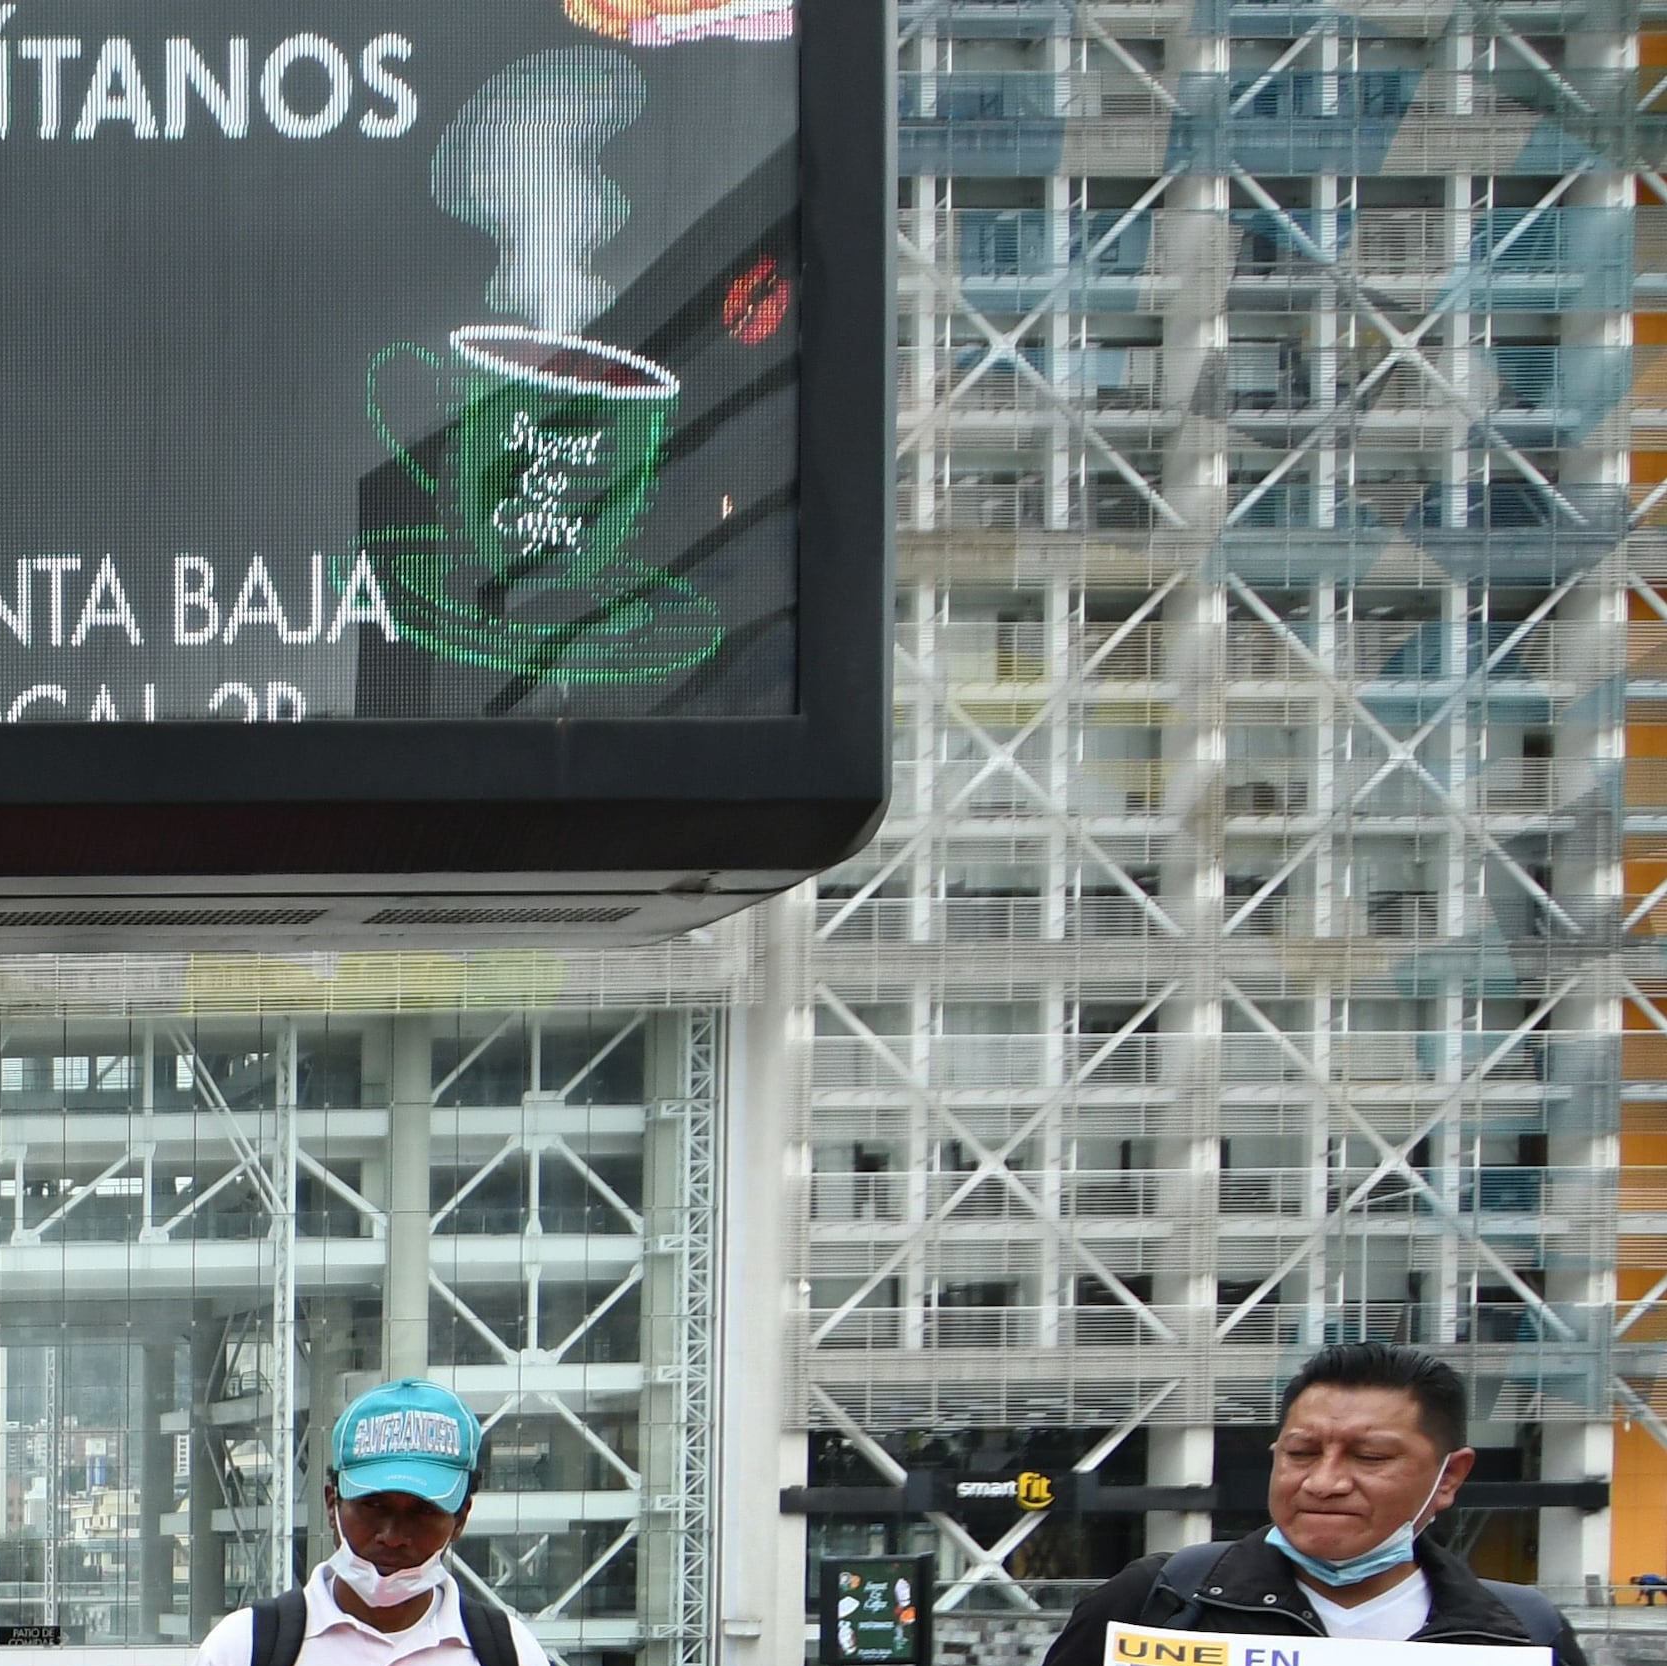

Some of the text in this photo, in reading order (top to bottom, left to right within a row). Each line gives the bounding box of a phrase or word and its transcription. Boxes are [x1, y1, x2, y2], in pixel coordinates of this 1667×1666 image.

[173, 549, 400, 647] BAJA
[42, 1627, 56, 1637] DE
[1119, 1638, 1224, 1665] UNE
